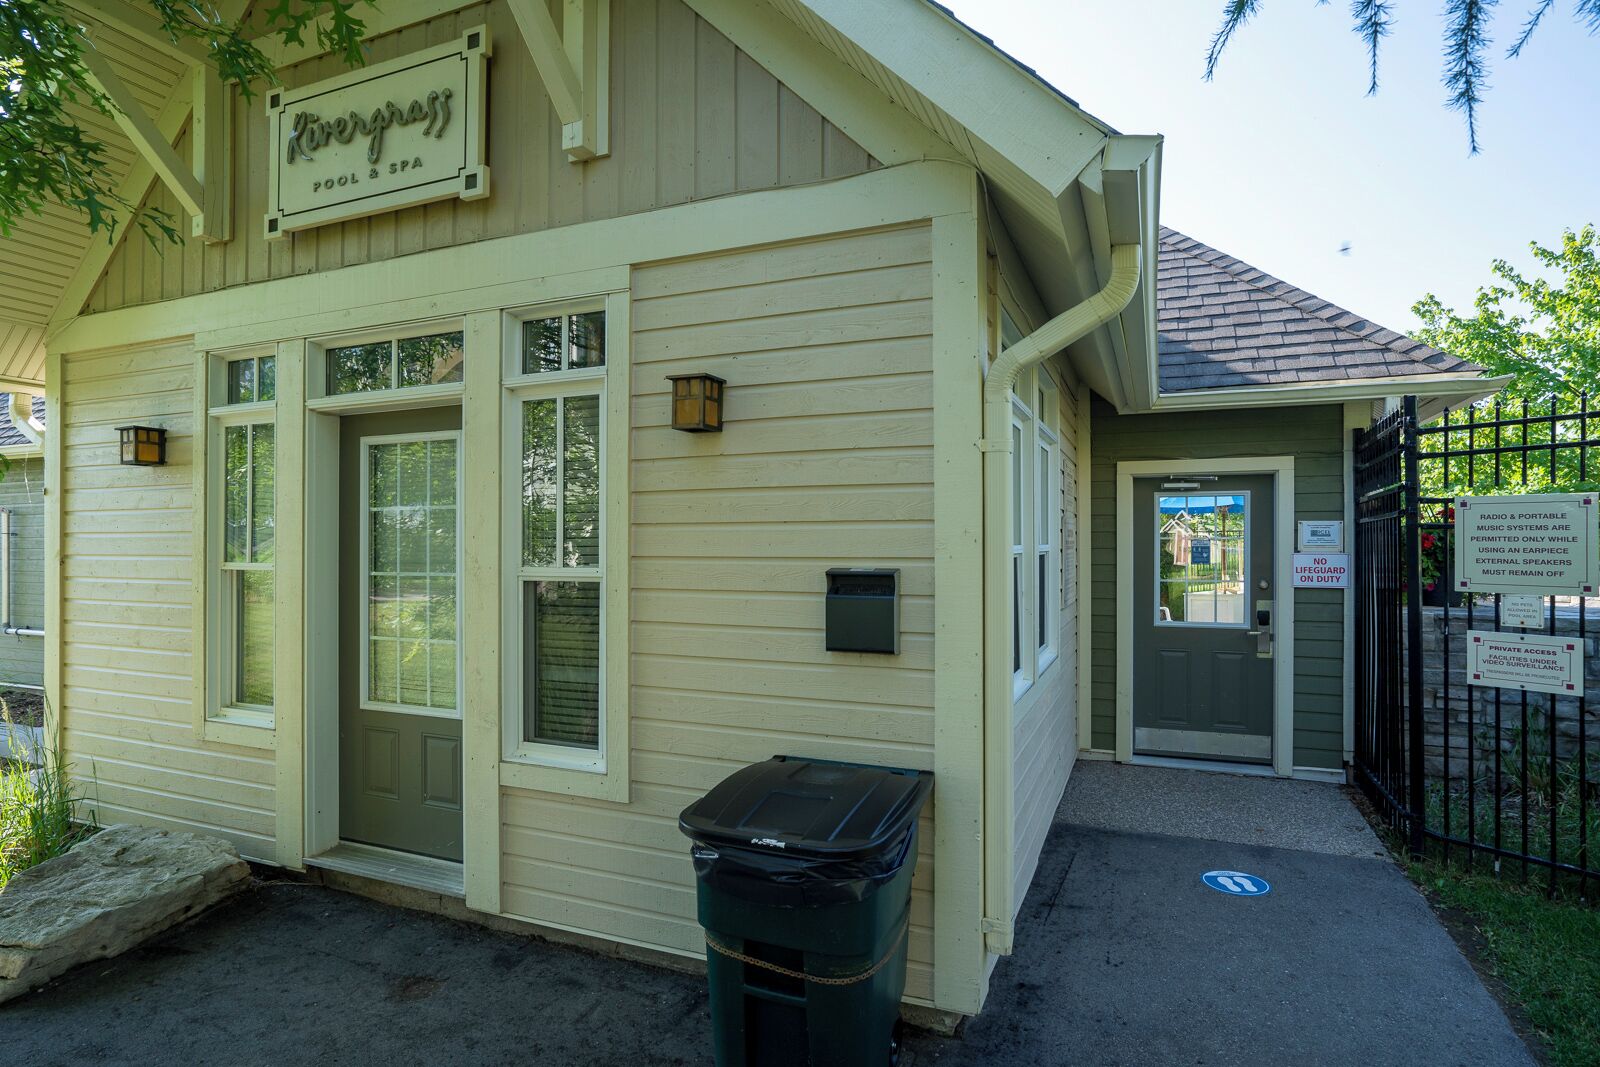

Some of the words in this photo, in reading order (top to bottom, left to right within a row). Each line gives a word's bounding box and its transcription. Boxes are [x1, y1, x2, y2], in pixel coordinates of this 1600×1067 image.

[286, 87, 453, 164] Rivergrass
[313, 172, 359, 192] POOL
[369, 168, 379, 179] &
[388, 157, 423, 174] SPA
[1506, 661, 1565, 671] SURVEILLANCE
